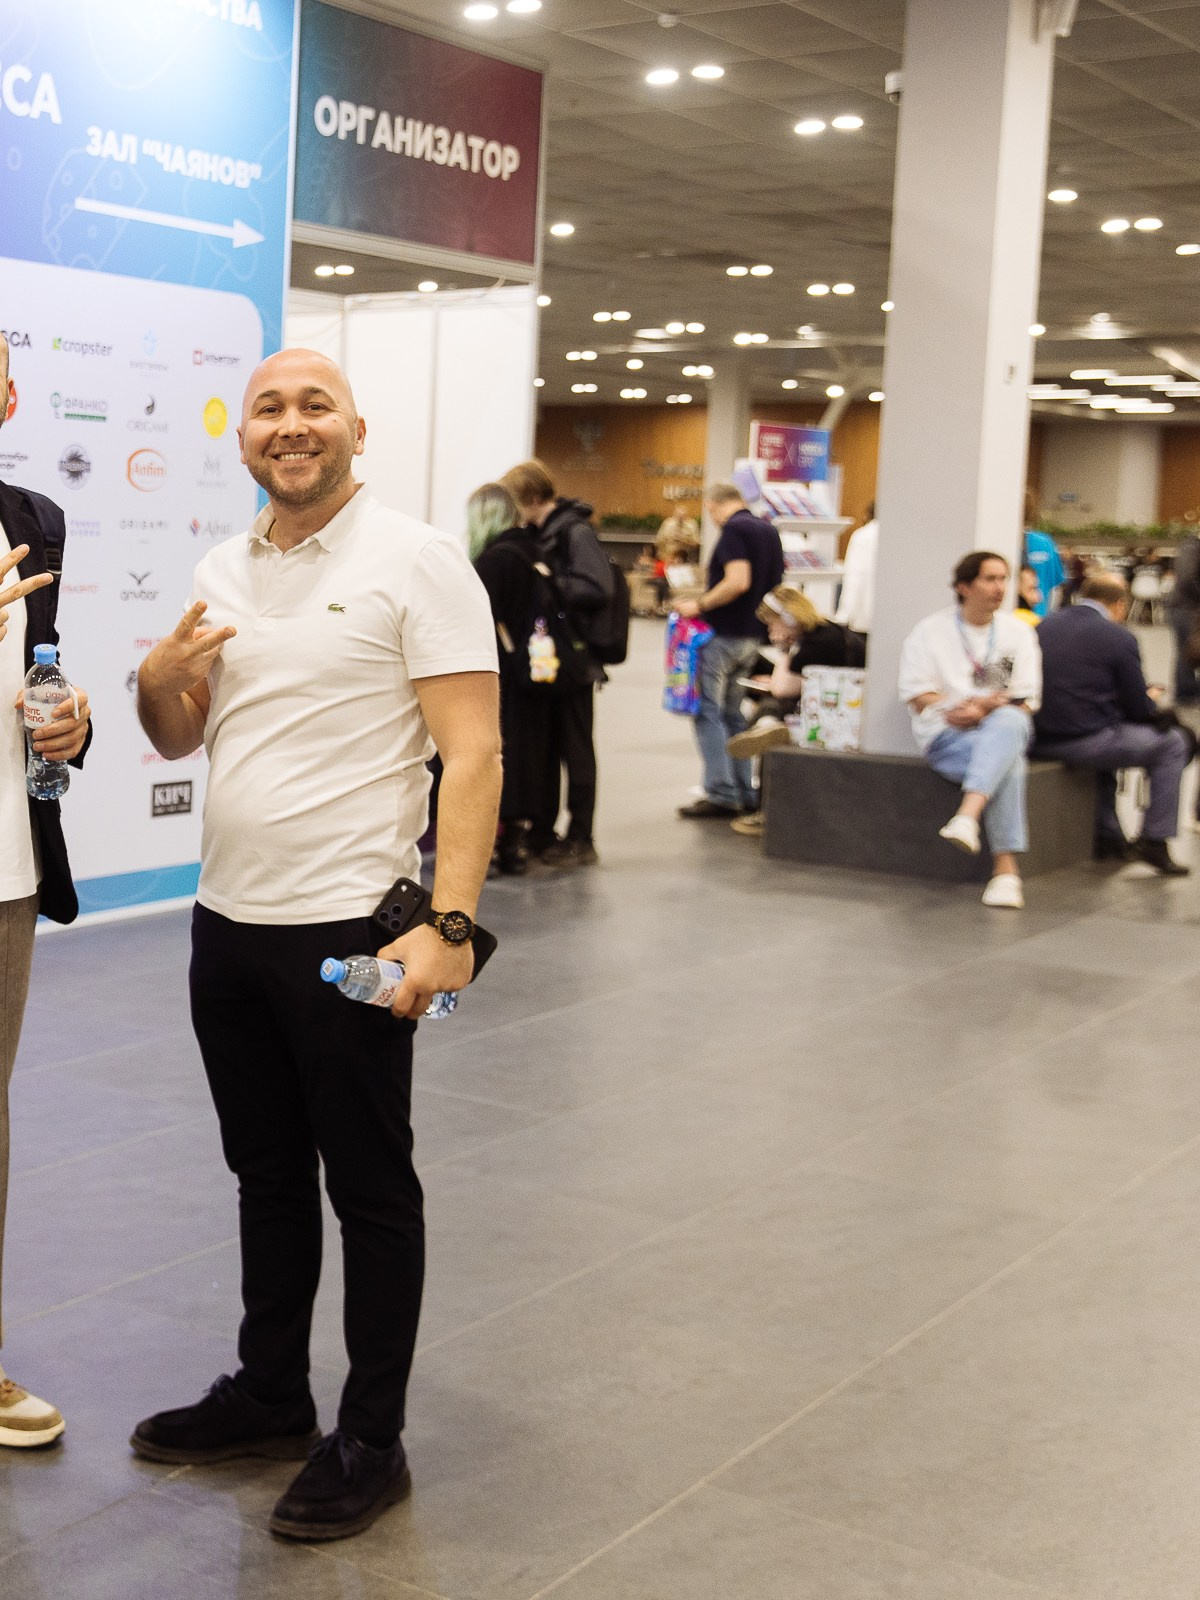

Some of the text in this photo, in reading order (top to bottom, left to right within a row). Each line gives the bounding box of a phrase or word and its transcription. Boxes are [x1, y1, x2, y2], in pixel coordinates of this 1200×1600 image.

[86, 125, 139, 164] ЗАЛ
[314, 95, 521, 182] ОРГАНИЗАТОР
[63, 340, 113, 358] cropster
